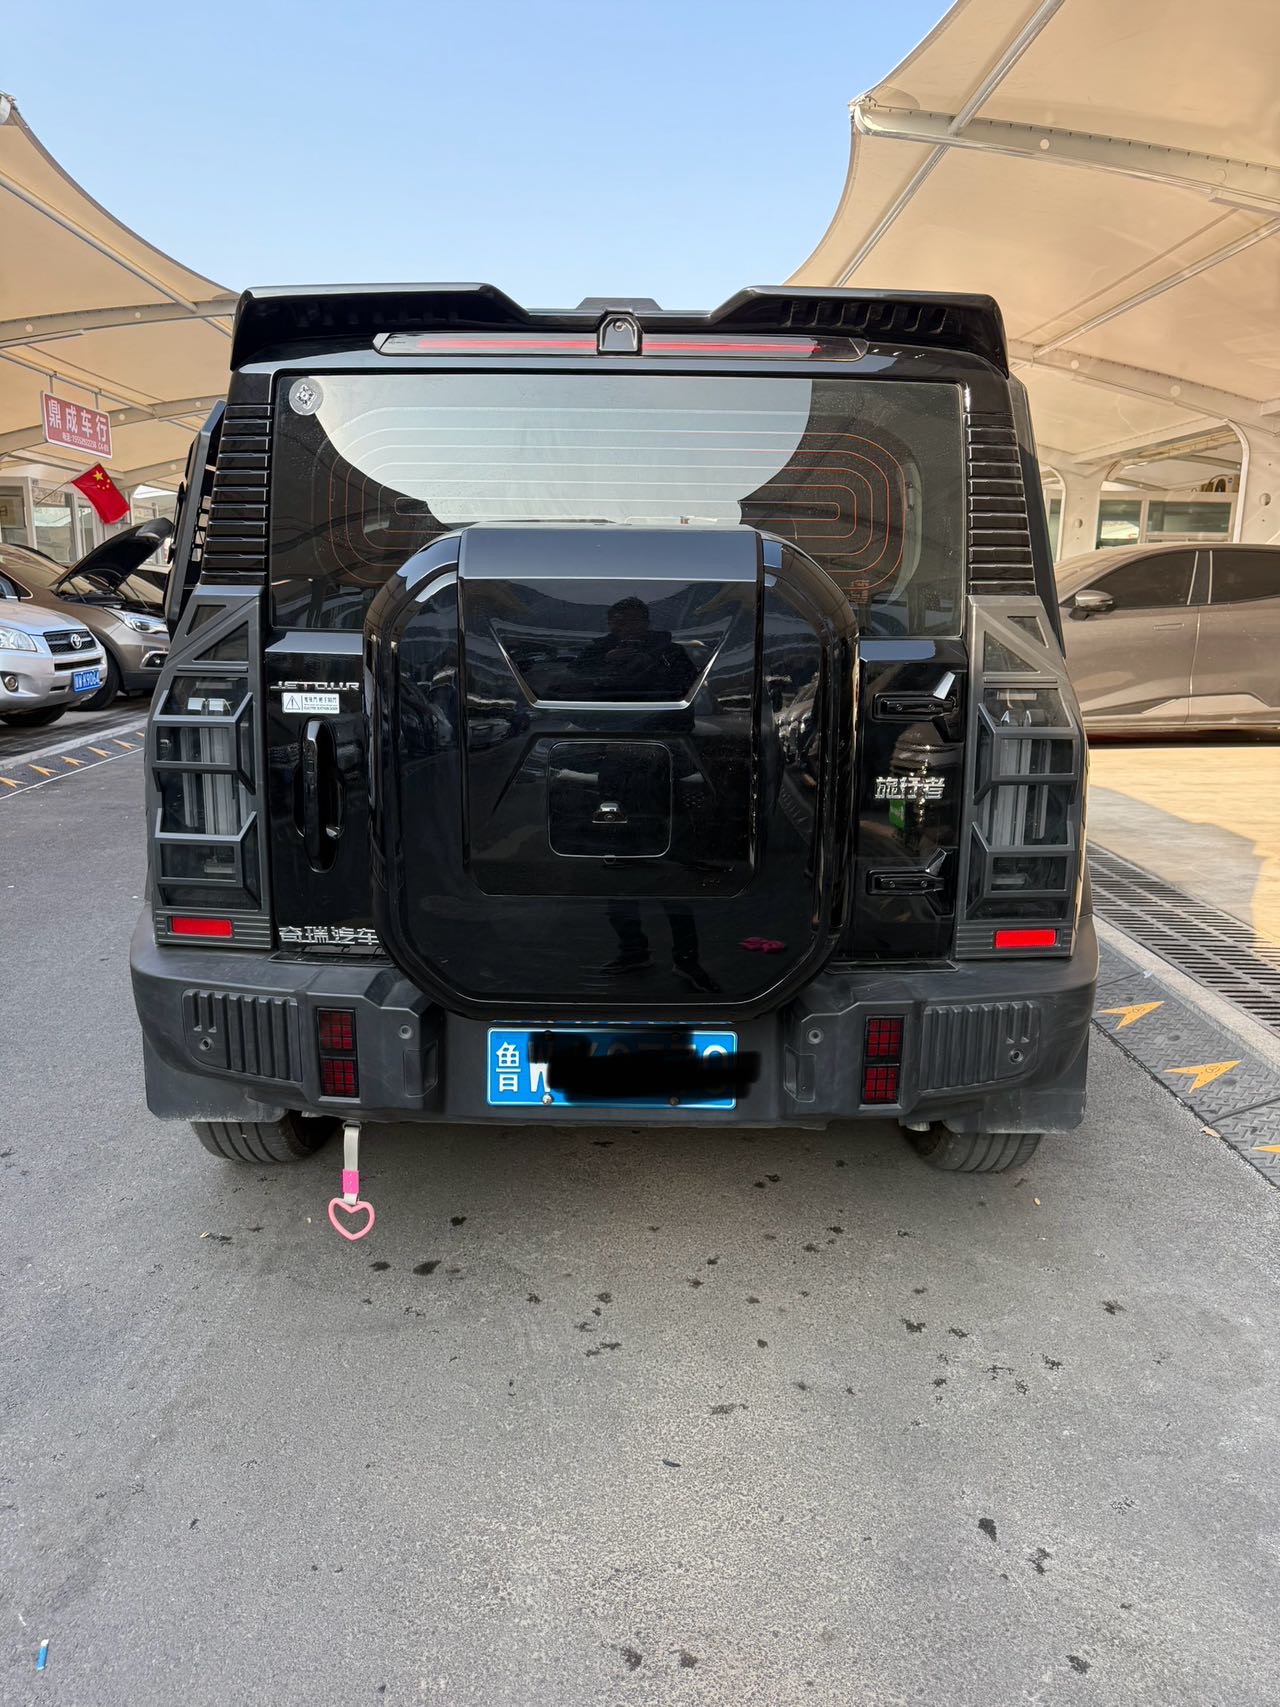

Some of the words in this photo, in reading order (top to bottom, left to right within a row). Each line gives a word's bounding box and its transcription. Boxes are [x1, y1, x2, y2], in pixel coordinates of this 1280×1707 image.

[48, 399, 107, 442] 鼎成车行
[269, 681, 360, 691] JETOUR
[874, 776, 945, 799] 旅行者
[278, 926, 380, 945] 奇瑞汽车
